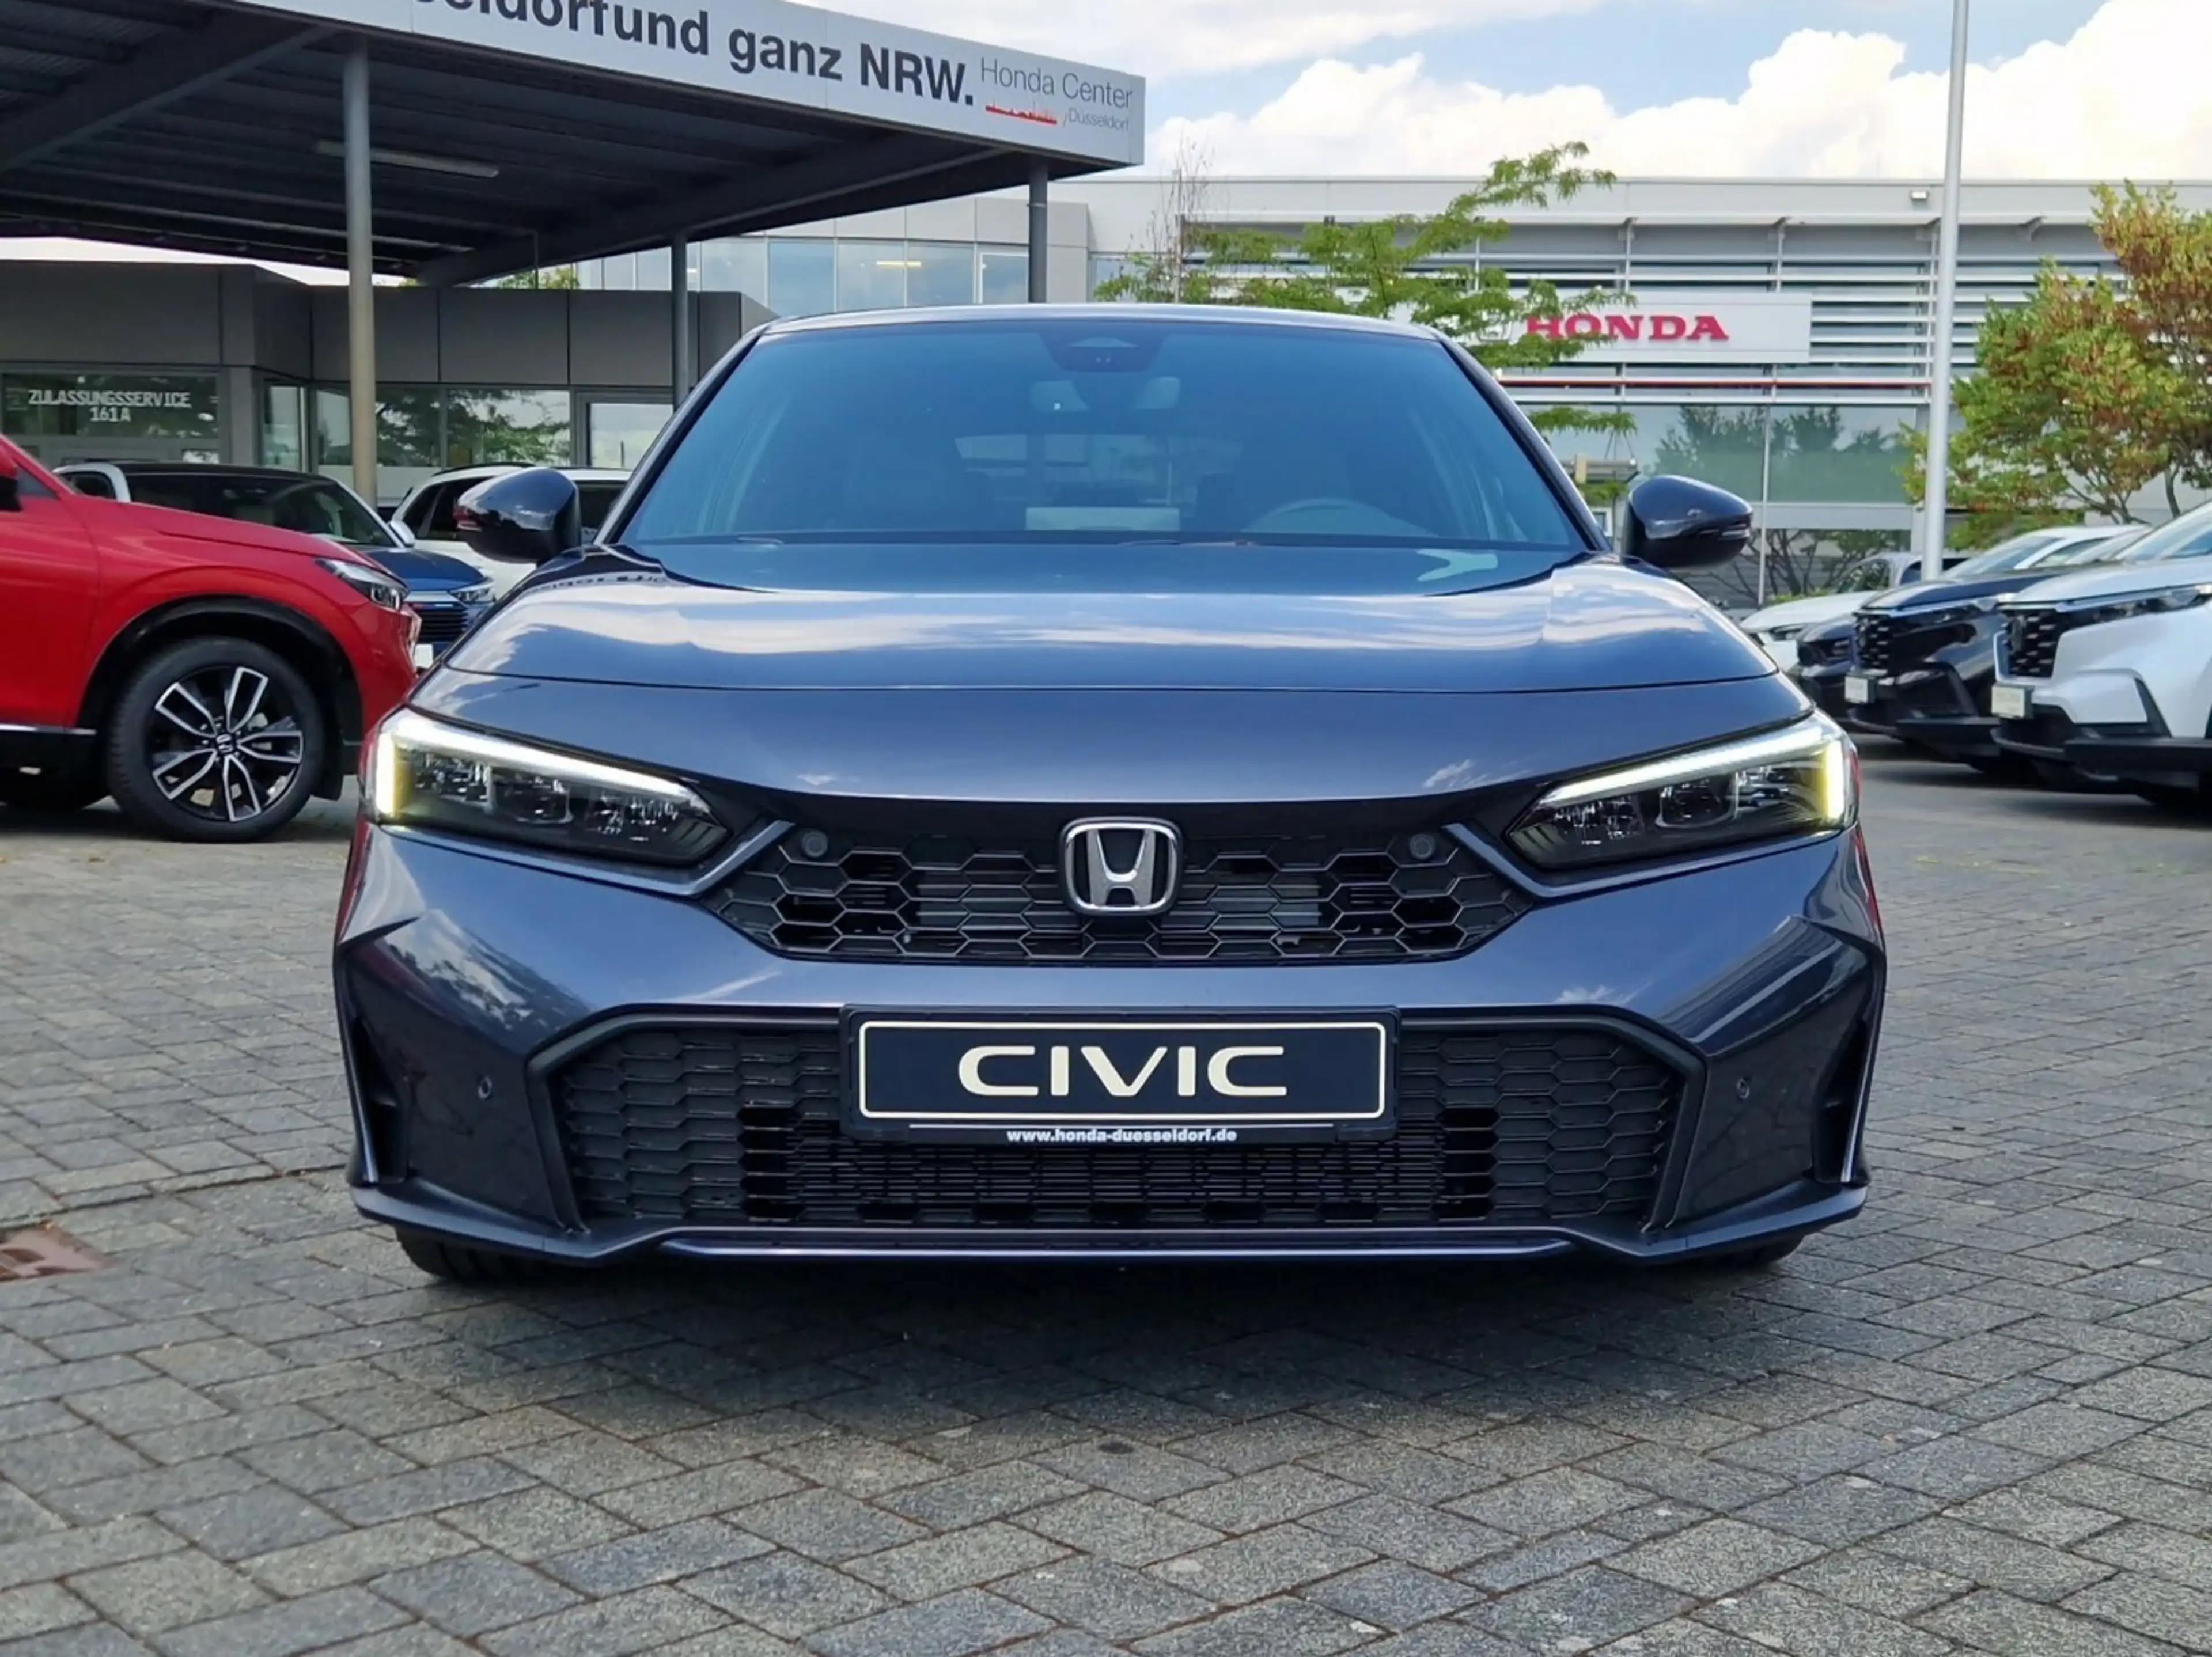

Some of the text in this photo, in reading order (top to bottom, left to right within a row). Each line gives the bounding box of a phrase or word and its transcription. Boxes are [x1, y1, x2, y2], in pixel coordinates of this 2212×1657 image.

[728, 28, 843, 81] ganz
[859, 43, 974, 106] NRW.
[980, 56, 1133, 109] Honda Center
[1523, 312, 1730, 342] HONDA
[28, 389, 192, 408] ZULASSUNGSSERVICE
[958, 1045, 1287, 1097] CIVIC
[1006, 1127, 1237, 1143] www.honda-duesseldorf.de
